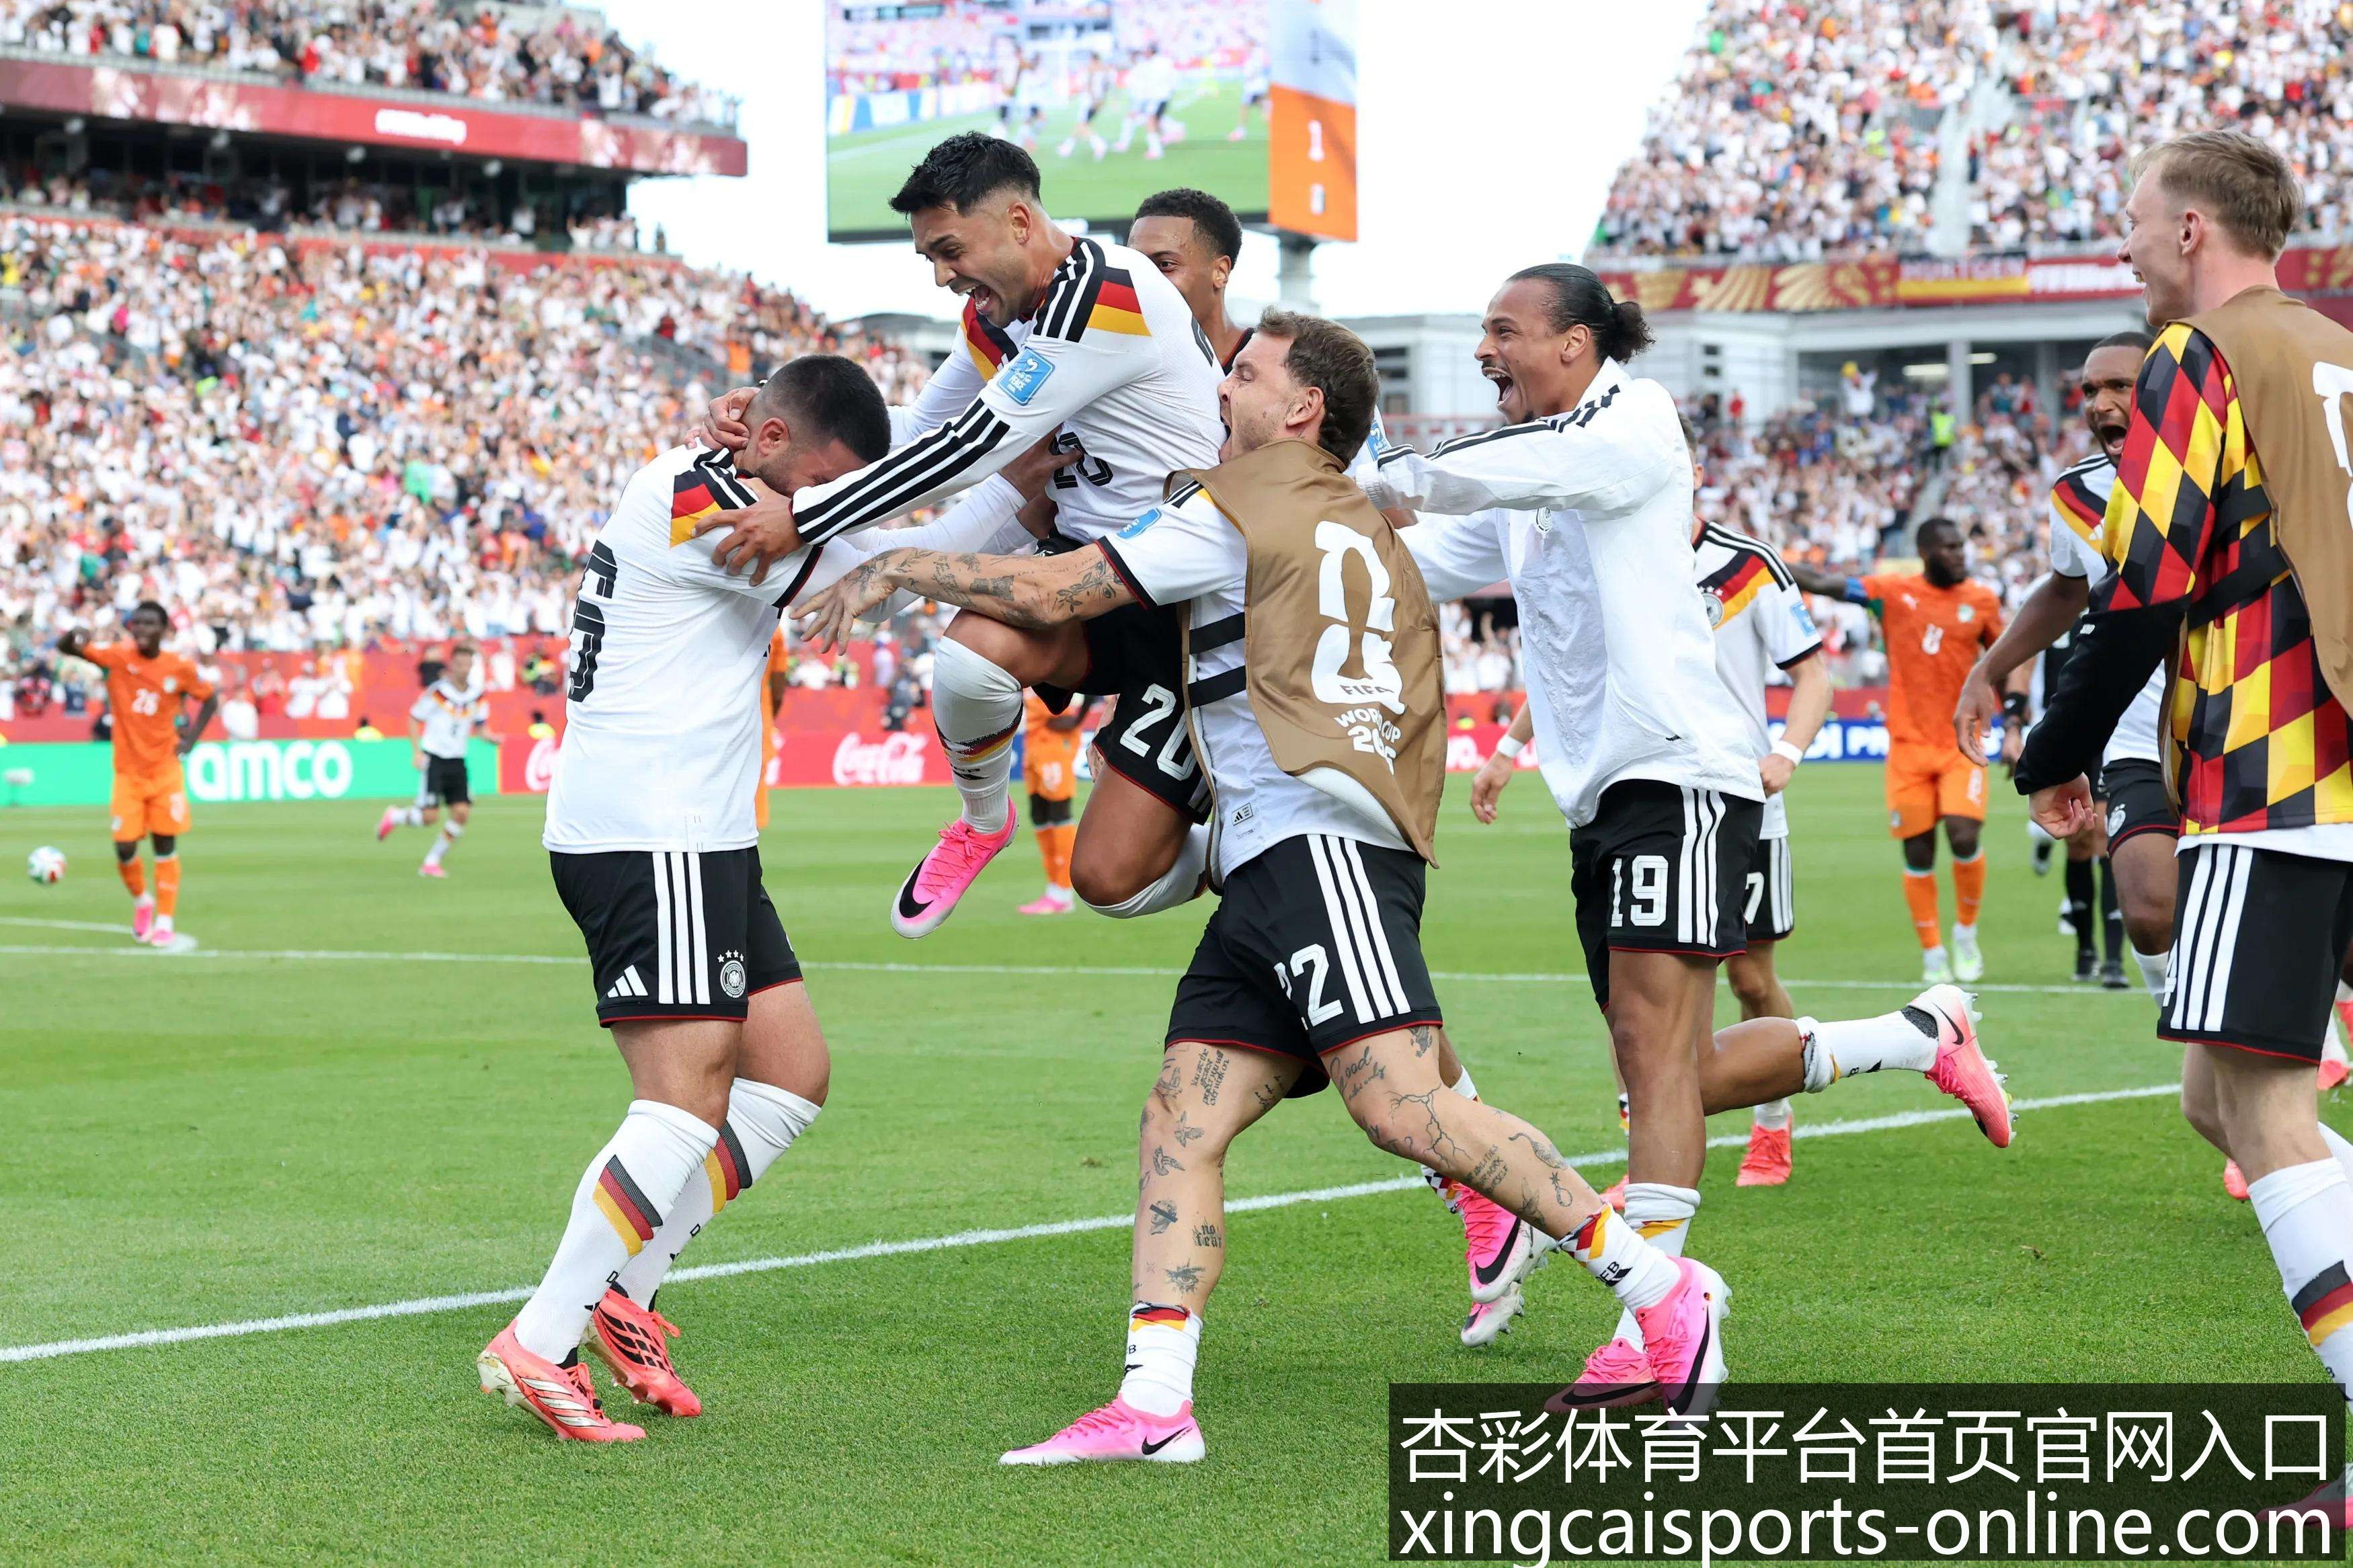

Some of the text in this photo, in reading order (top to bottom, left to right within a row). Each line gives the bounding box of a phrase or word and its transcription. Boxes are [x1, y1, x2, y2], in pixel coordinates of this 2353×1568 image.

[1308, 120, 1324, 161] 1
[1339, 684, 1394, 696] FIFA
[1611, 855, 1669, 927] 19
[1744, 872, 1765, 925] 7
